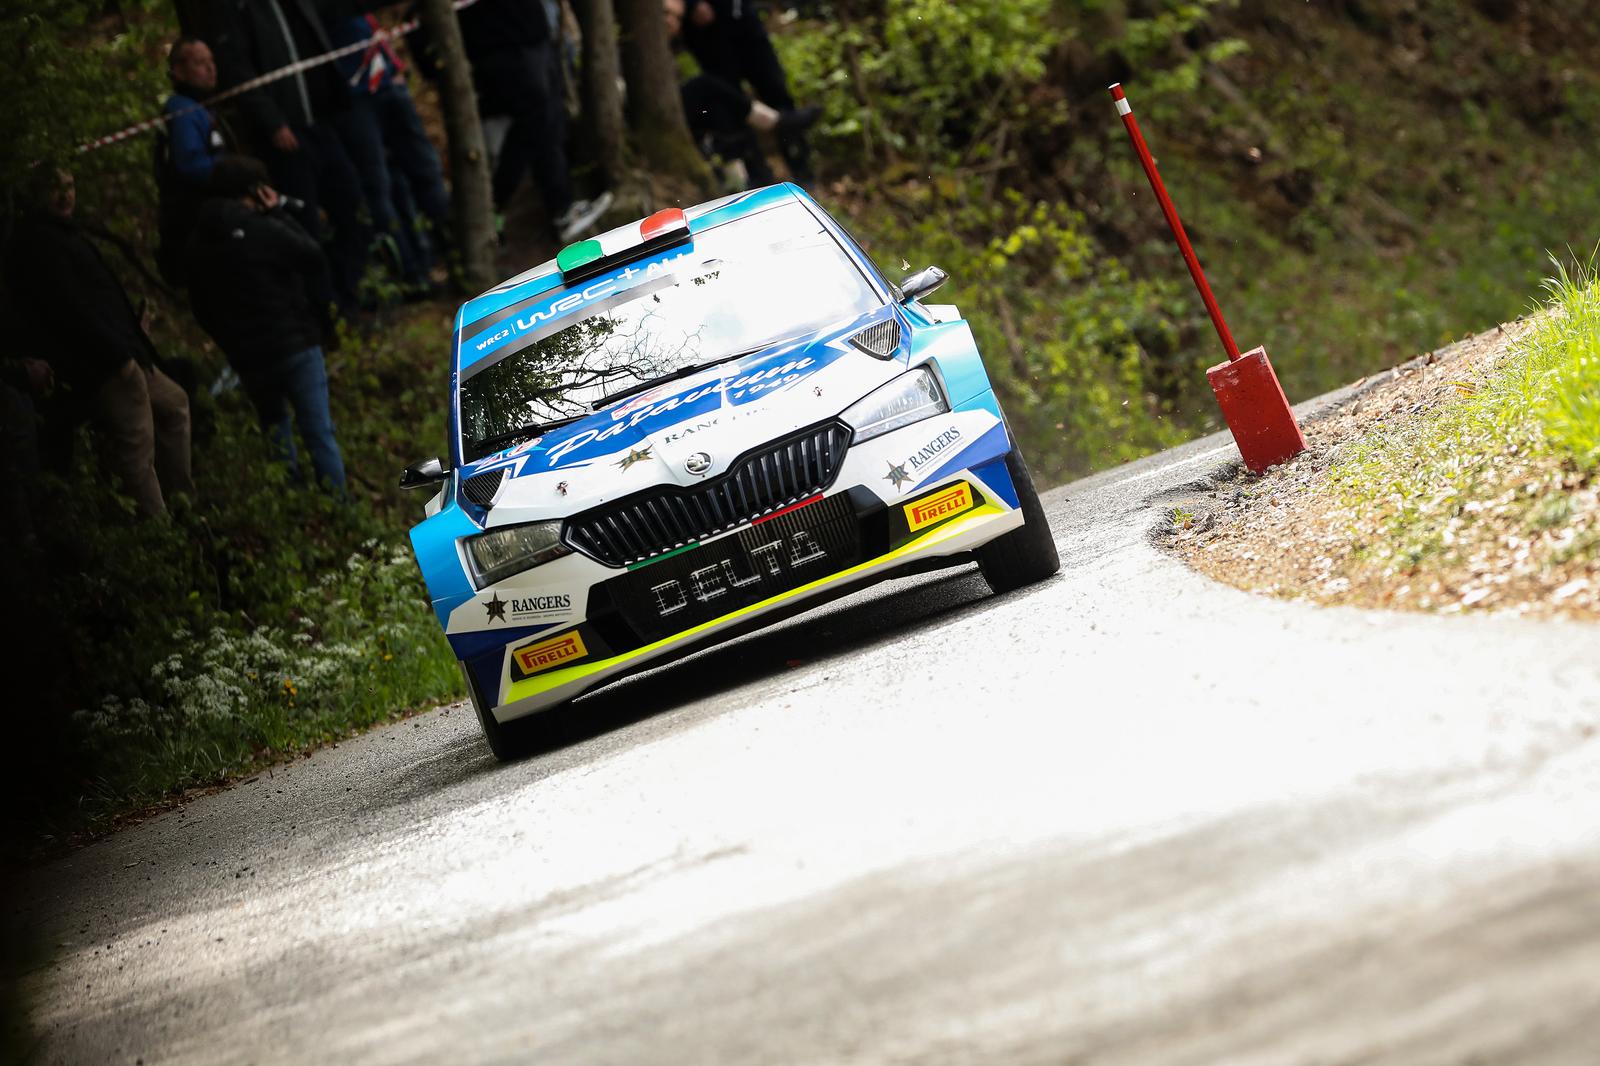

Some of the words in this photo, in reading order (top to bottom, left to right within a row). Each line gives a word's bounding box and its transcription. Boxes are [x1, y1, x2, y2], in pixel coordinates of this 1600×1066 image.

[475, 329, 510, 351] WRC2
[545, 357, 816, 466] Patavium
[907, 425, 961, 469] RANGERS
[911, 489, 967, 525] PIRELLI
[651, 531, 828, 617] DELTA
[511, 594, 571, 613] RANGERS
[520, 638, 578, 670] PIRELLI
